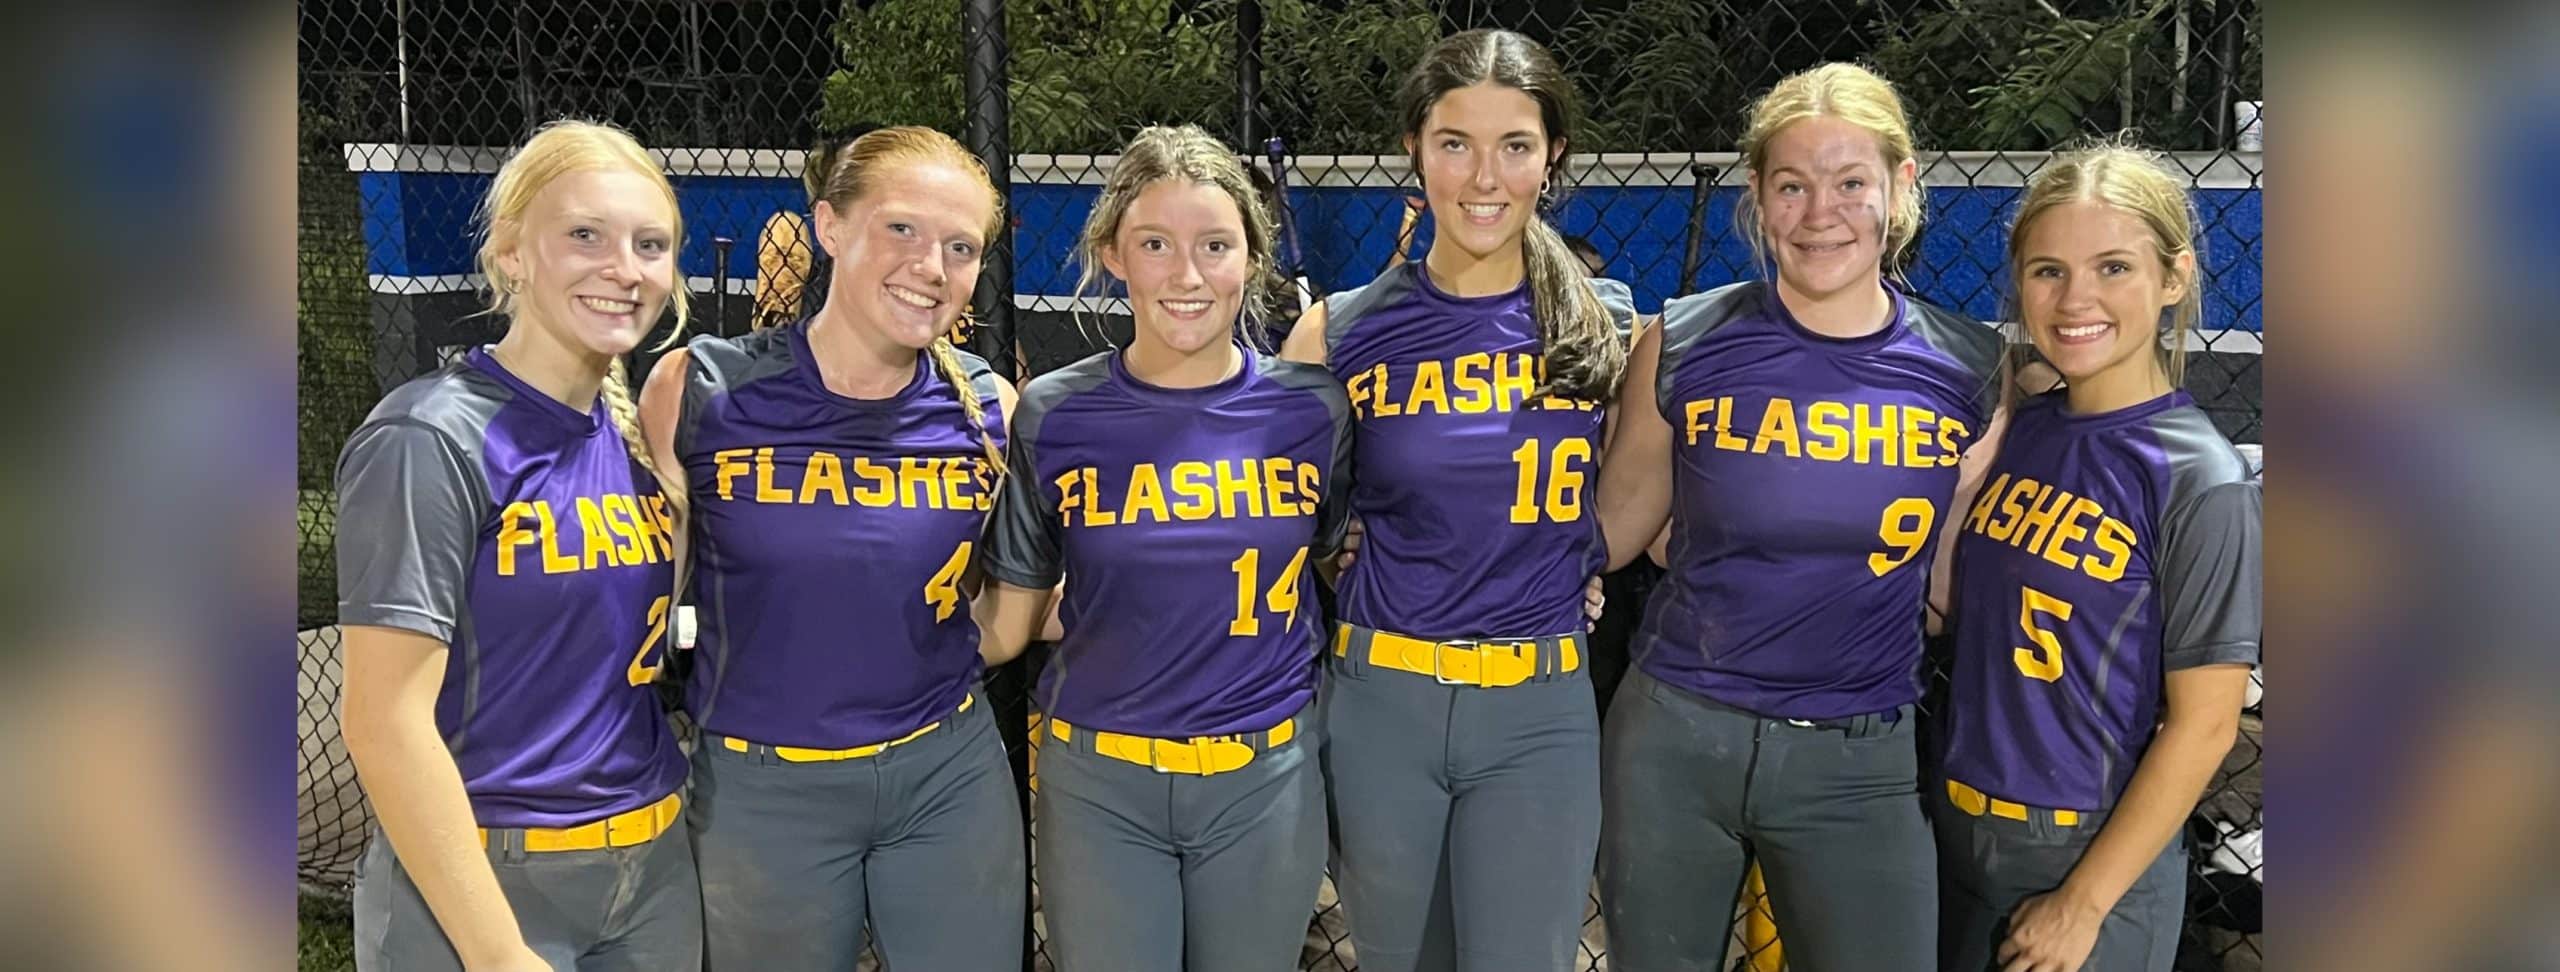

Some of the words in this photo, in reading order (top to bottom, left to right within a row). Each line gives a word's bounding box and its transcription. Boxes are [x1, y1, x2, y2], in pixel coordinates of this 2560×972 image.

[1346, 352, 1596, 421] FLASH
[1685, 396, 1970, 468] FLASHES
[1054, 456, 1321, 527] FLASHES
[1510, 437, 1592, 524] 16
[1867, 497, 1936, 577] 9
[924, 541, 973, 625] 4
[1229, 546, 1309, 636] 14
[2013, 586, 2073, 683] 5
